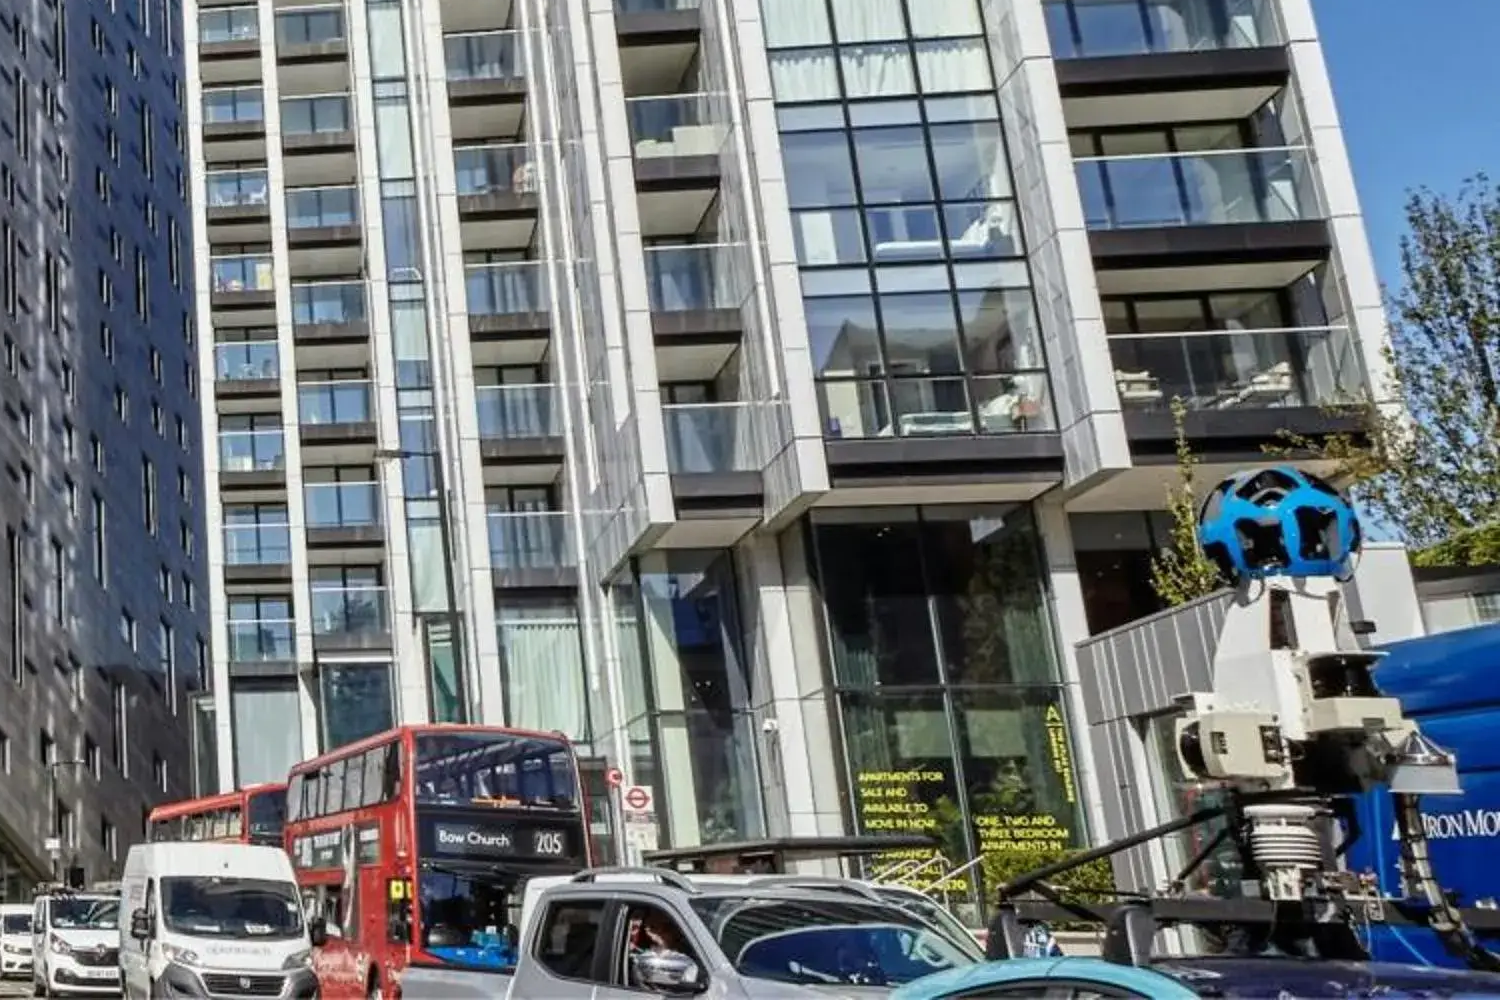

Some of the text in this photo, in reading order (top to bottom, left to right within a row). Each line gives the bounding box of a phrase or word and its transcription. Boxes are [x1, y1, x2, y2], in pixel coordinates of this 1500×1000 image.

[858, 771, 944, 782] APARTMENTS FOR
[860, 787, 908, 797] SALE AND
[862, 803, 929, 813] AVAILABLE TO
[865, 818, 895, 829] MOVE
[896, 818, 908, 829] IN
[1004, 815, 1030, 826] TWO
[1031, 815, 1055, 826] AND
[1420, 812, 1464, 839] IRON
[979, 828, 1069, 838] THREE BEDROOM
[439, 829, 562, 854] Bow Church 205
[981, 841, 1062, 851] APARTMENTS IN
